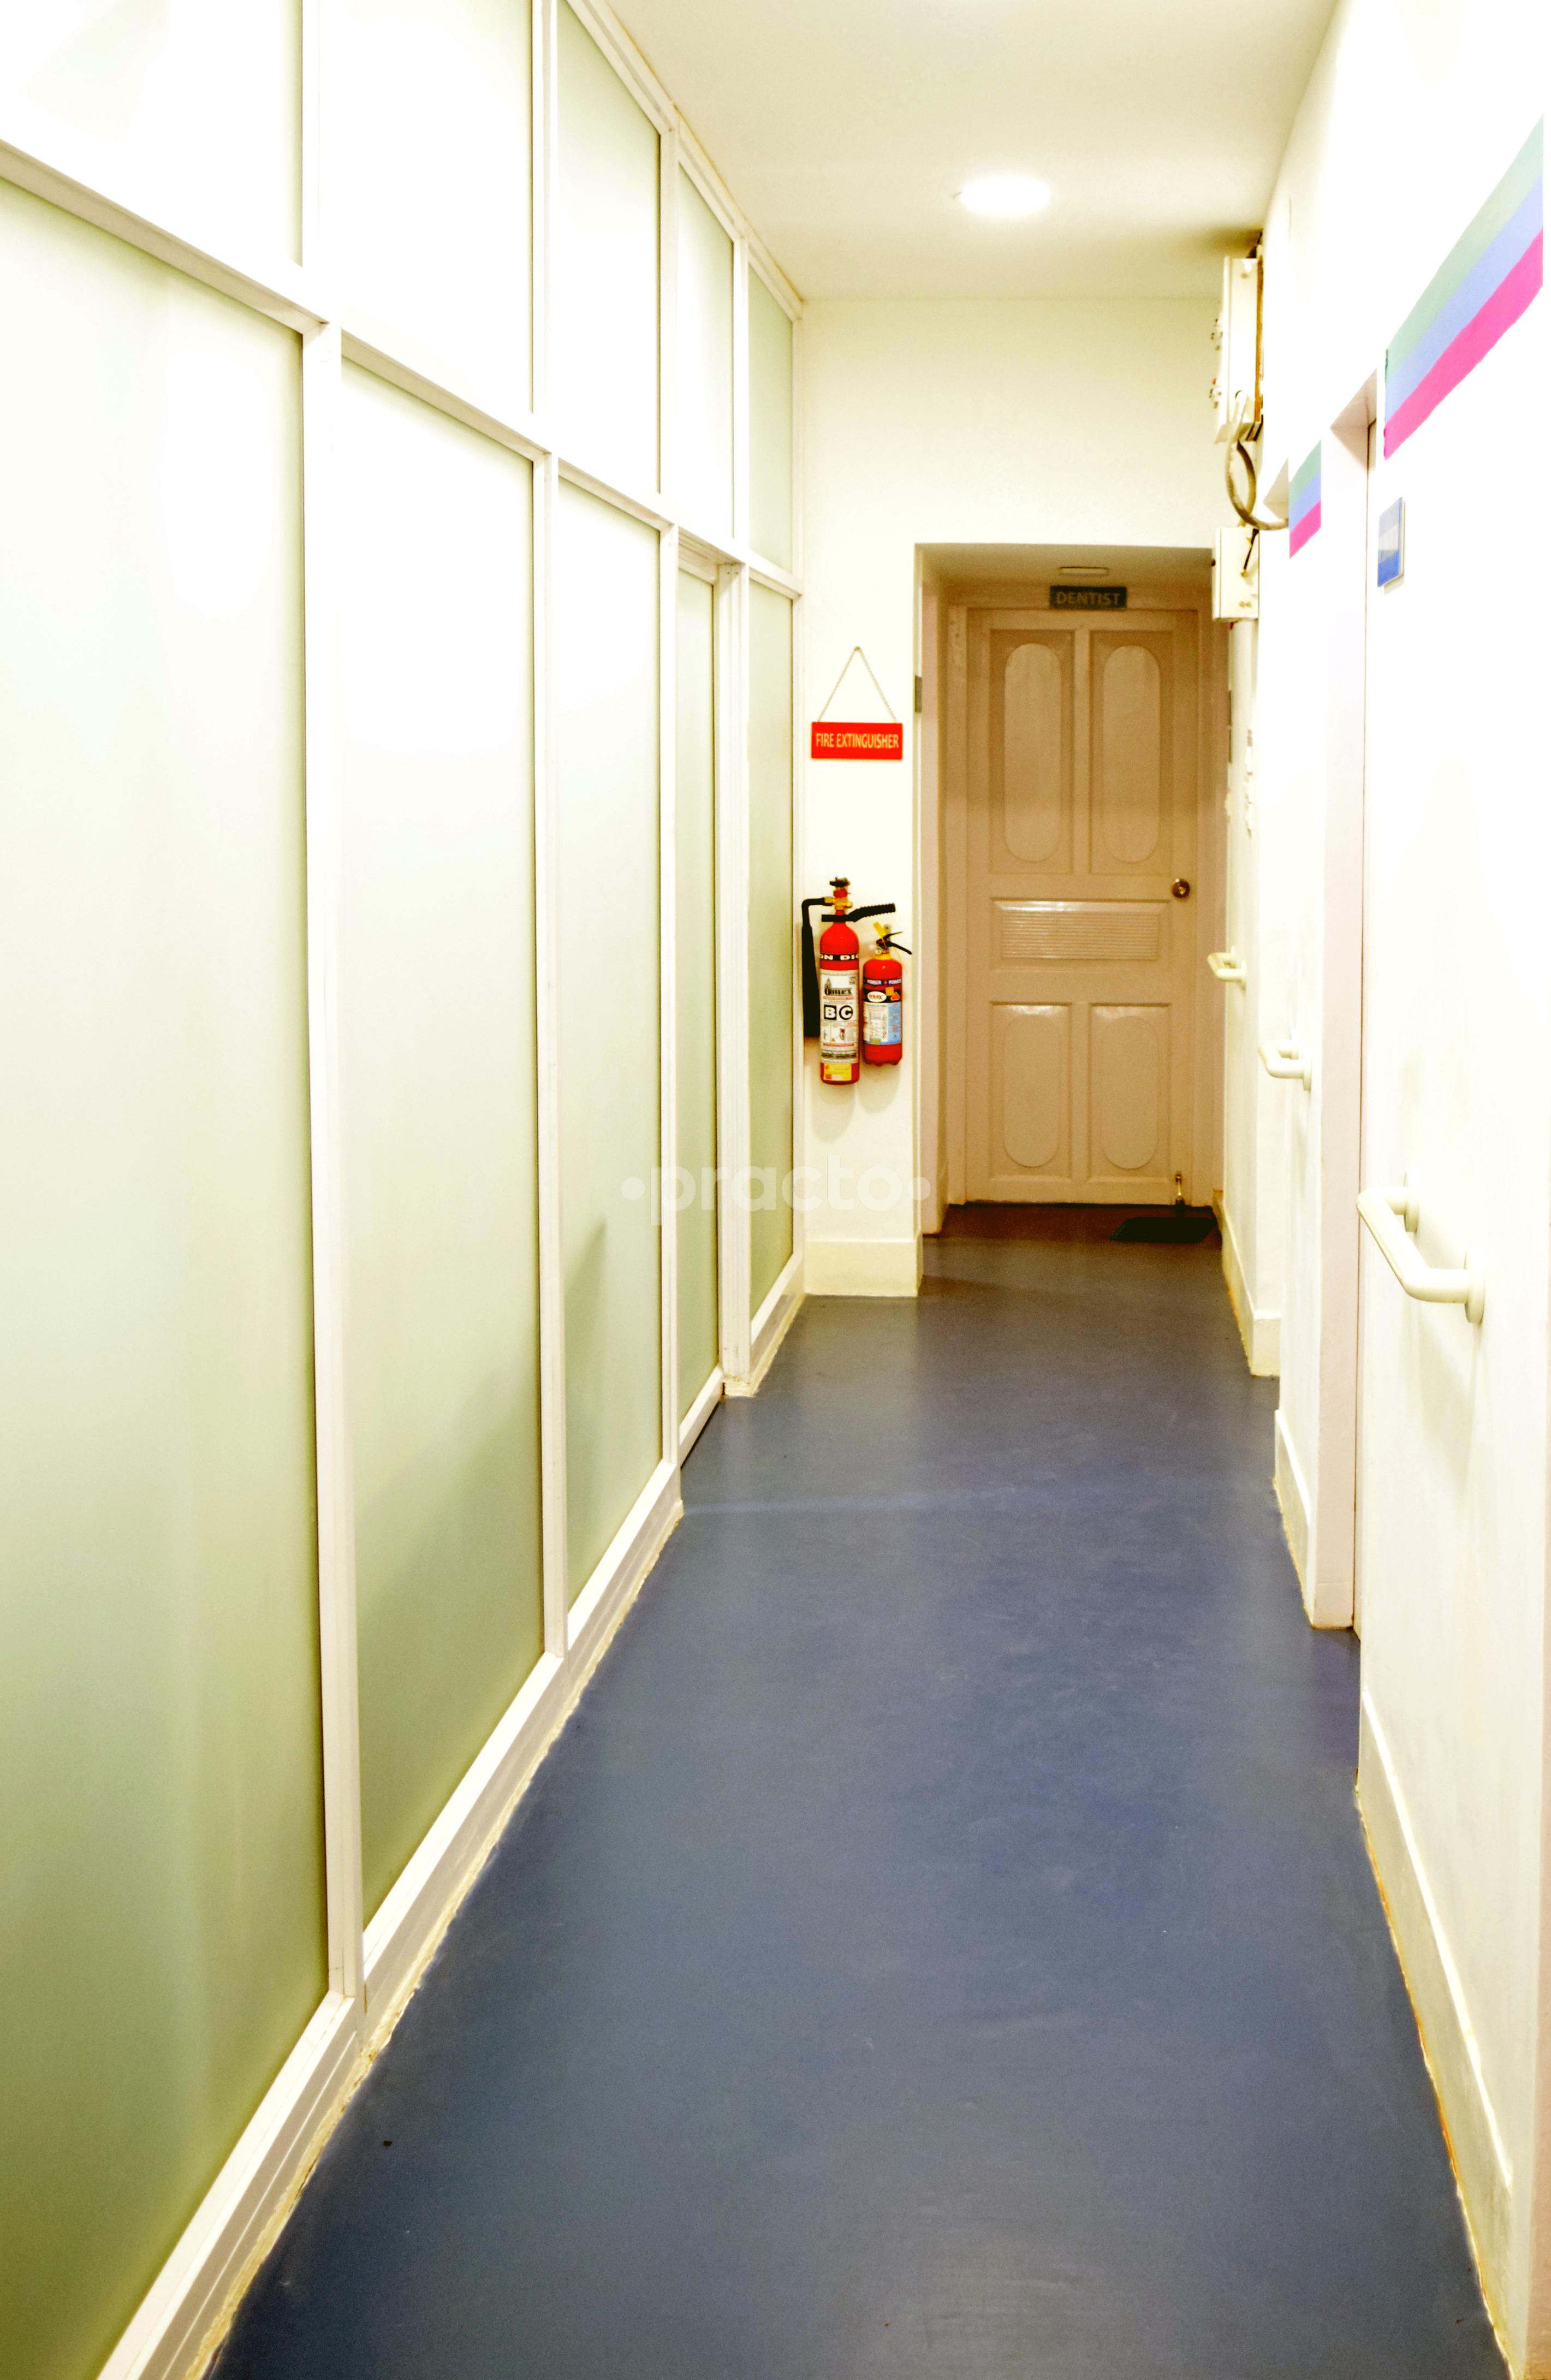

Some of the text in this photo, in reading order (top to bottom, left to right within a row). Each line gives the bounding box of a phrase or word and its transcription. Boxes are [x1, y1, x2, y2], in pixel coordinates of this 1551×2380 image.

[1056, 591, 1121, 606] DENTIST
[816, 733, 899, 749] FIRE EXTINGUISHER
